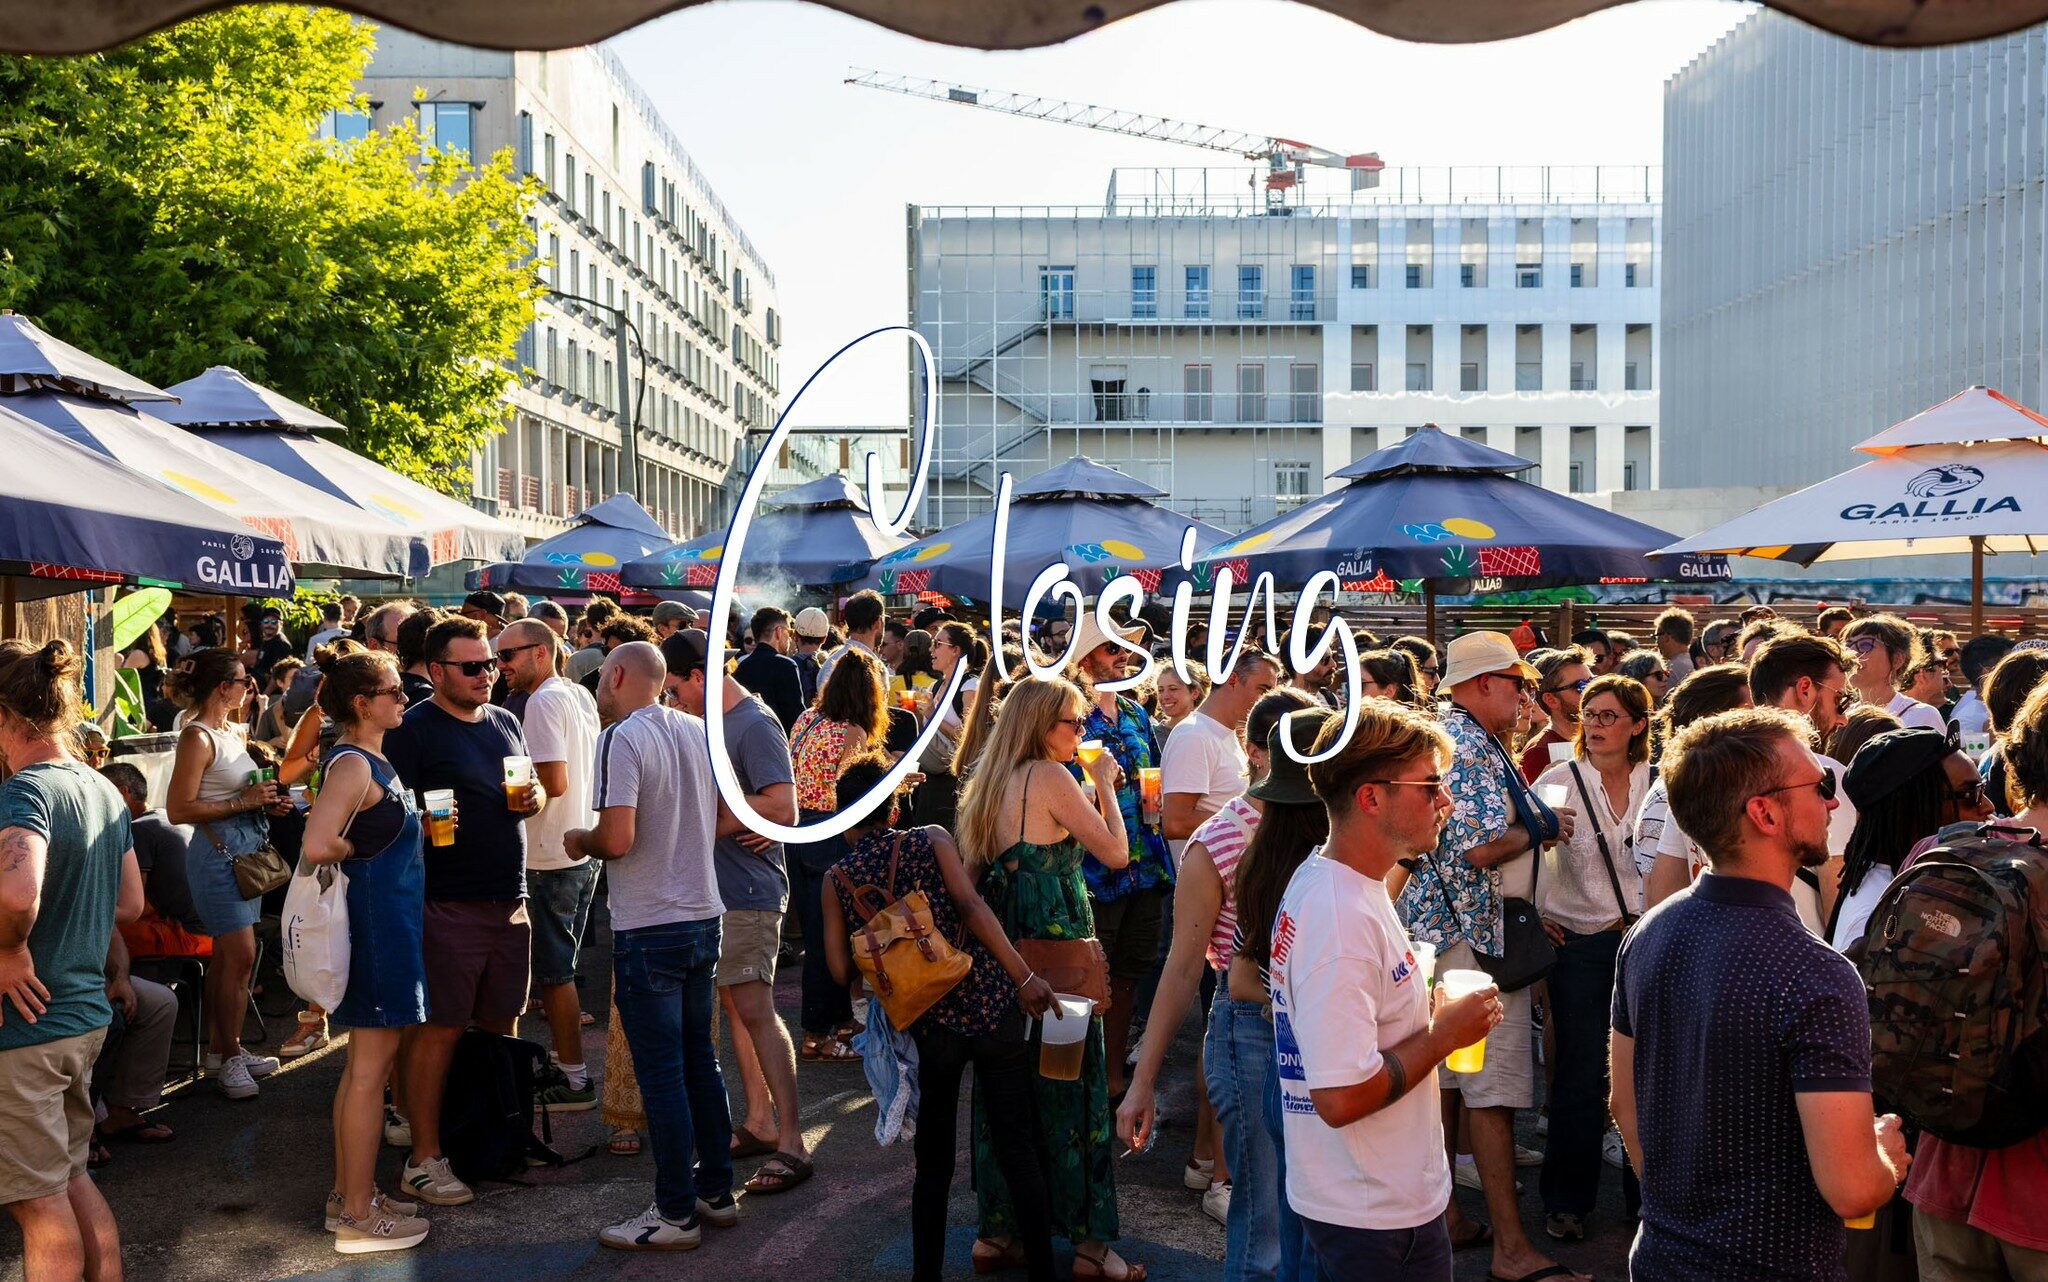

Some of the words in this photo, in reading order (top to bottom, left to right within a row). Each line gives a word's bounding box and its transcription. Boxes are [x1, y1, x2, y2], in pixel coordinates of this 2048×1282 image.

[1840, 496, 2022, 520] GALLIA
[202, 540, 226, 549] PARIS
[196, 556, 290, 591] GALLIA
[1680, 563, 1731, 578] GALLIA
[1920, 912, 1949, 927] NORTH
[1936, 909, 1952, 921] THE
[1925, 920, 1947, 933] FACE
